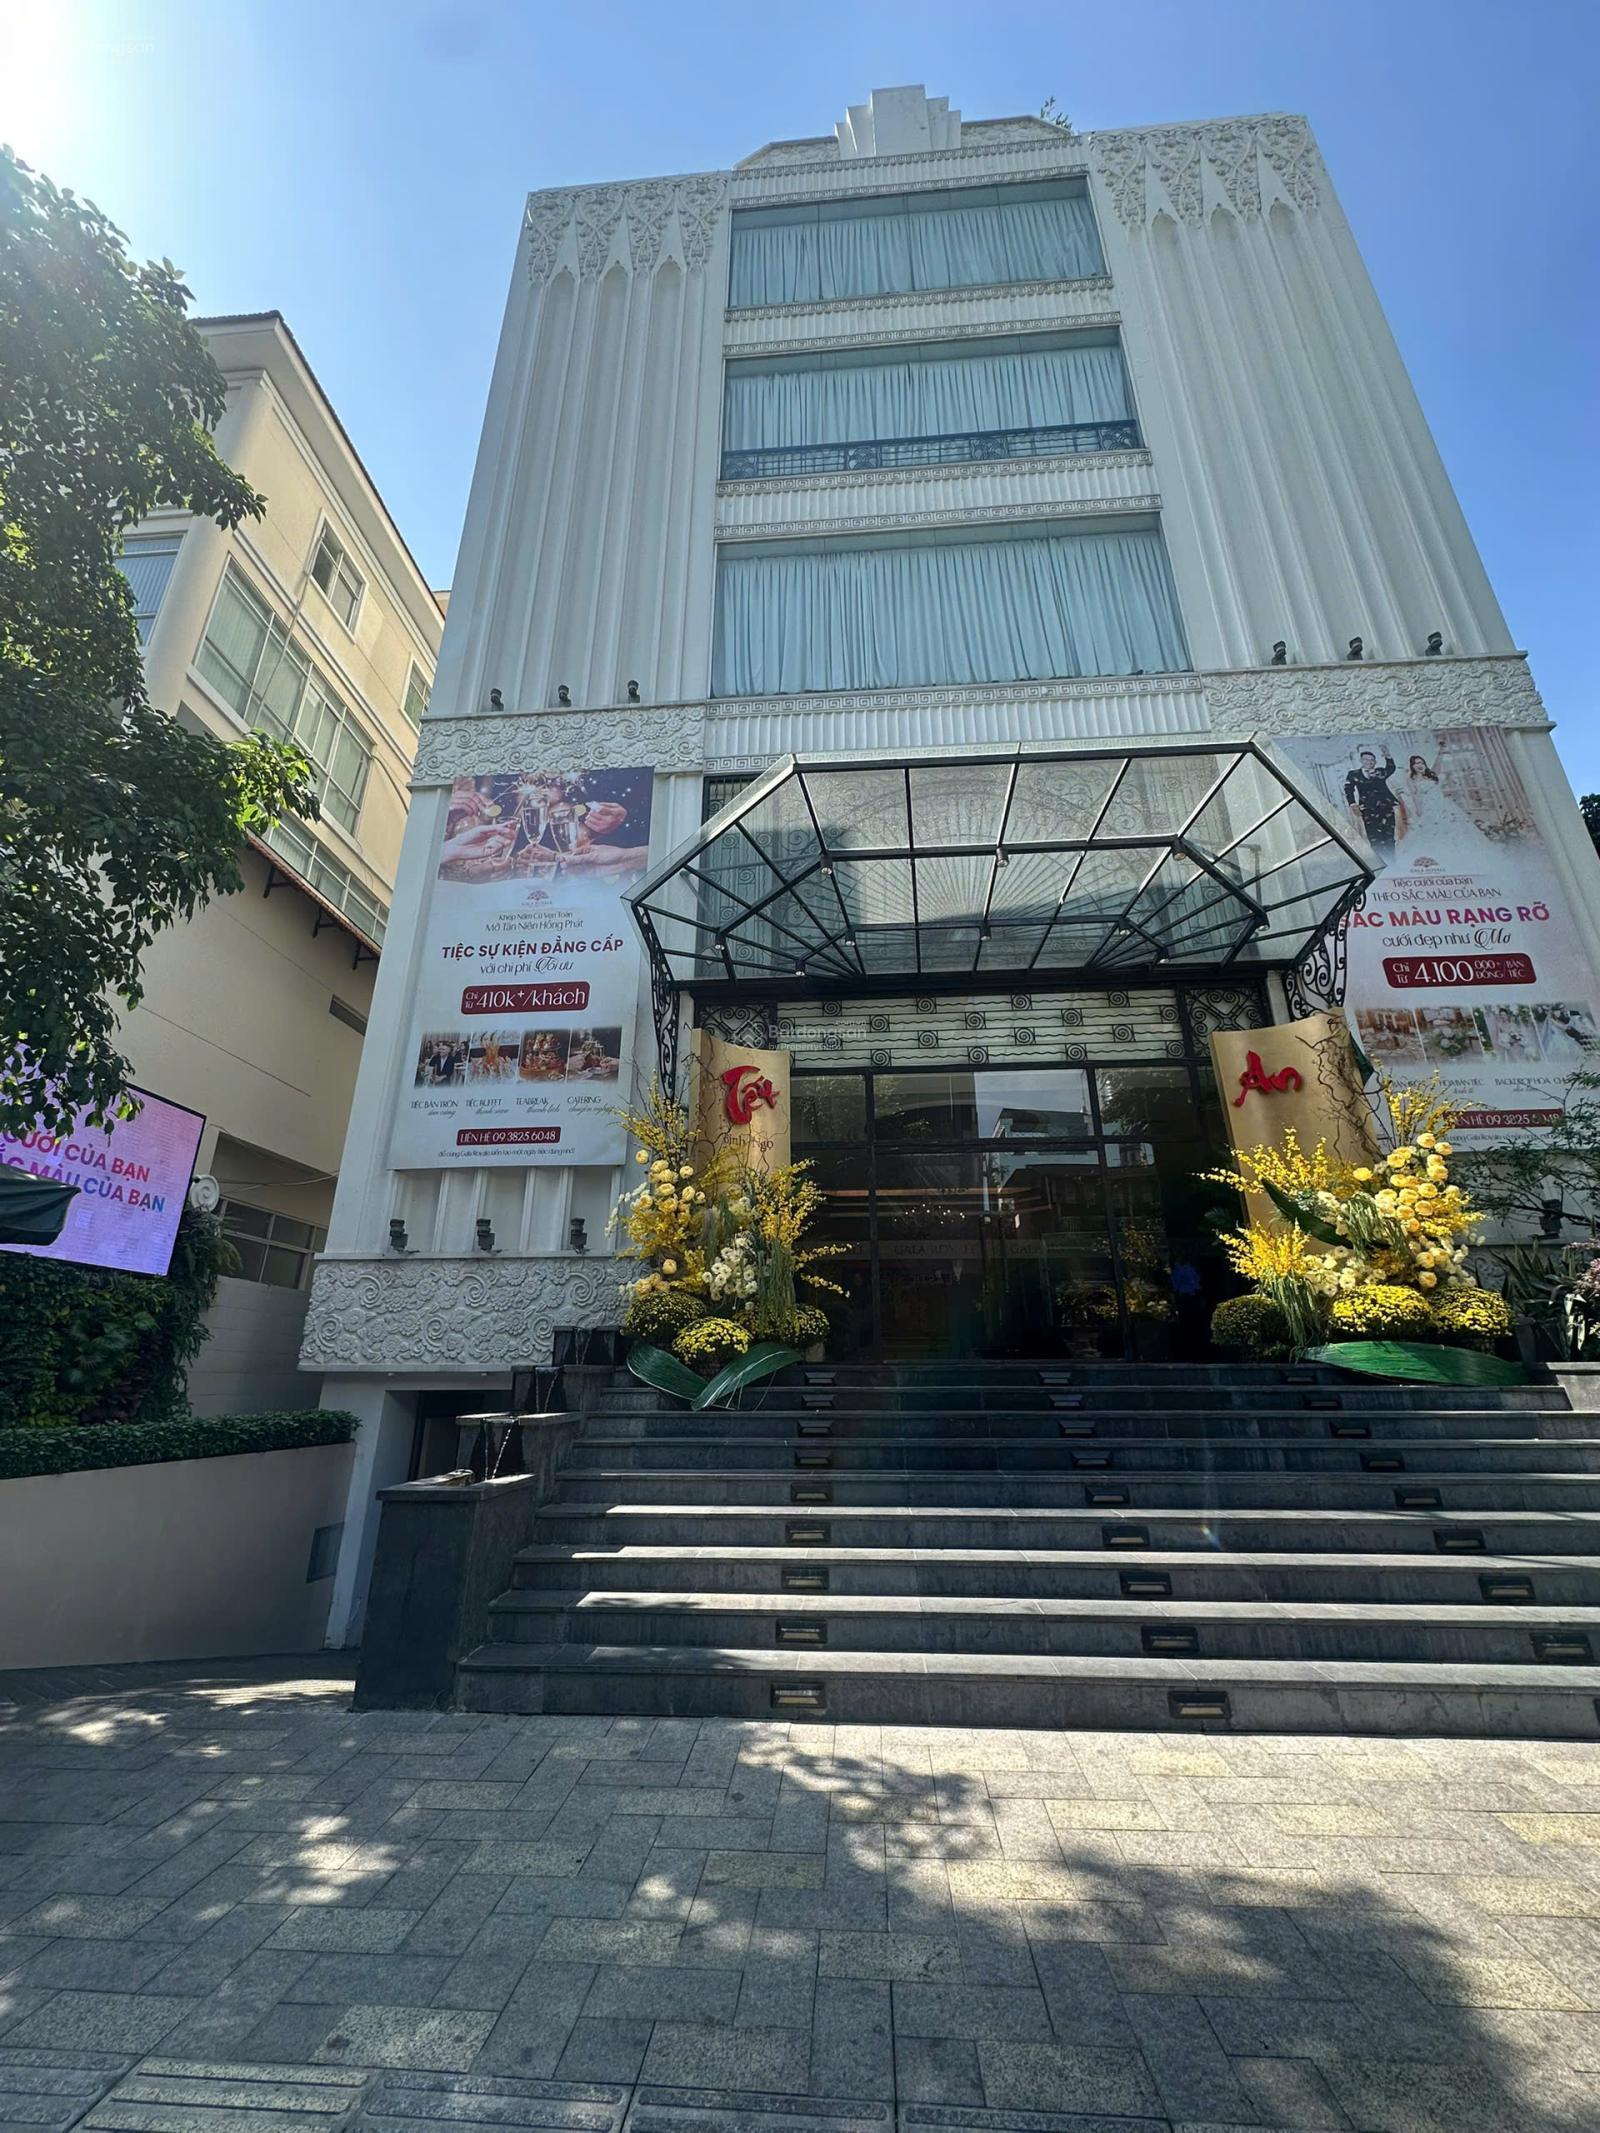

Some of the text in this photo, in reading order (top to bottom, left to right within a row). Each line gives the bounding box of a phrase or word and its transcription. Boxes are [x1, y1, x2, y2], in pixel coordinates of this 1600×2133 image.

[1371, 891, 1401, 902] THEO
[1426, 888, 1452, 899] MÀU
[1453, 886, 1478, 899] CỦA
[1388, 906, 1442, 927] MÀU
[1446, 907, 1513, 927] RẠNG
[1516, 901, 1550, 921] RỠ
[442, 933, 624, 961] TIỆC SỰ KIỆN ĐẲNG CẤP
[1382, 932, 1412, 947] cưới
[1414, 932, 1443, 949] đẹp
[1445, 932, 1471, 945] như
[480, 962, 496, 974] với
[1414, 960, 1474, 983] 4.100
[1232, 1050, 1302, 1107] An
[567, 1095, 602, 1105] CATERING
[1486, 1114, 1501, 1125] 09
[1503, 1113, 1530, 1125] 3825
[492, 1132, 506, 1142] 09
[507, 1131, 530, 1142] 3825
[531, 1130, 556, 1141] 6048
[64, 1144, 107, 1170] CỦA
[111, 1157, 150, 1182] BẠN
[83, 1176, 124, 1202] CỦA
[128, 1189, 165, 1212] BẠN
